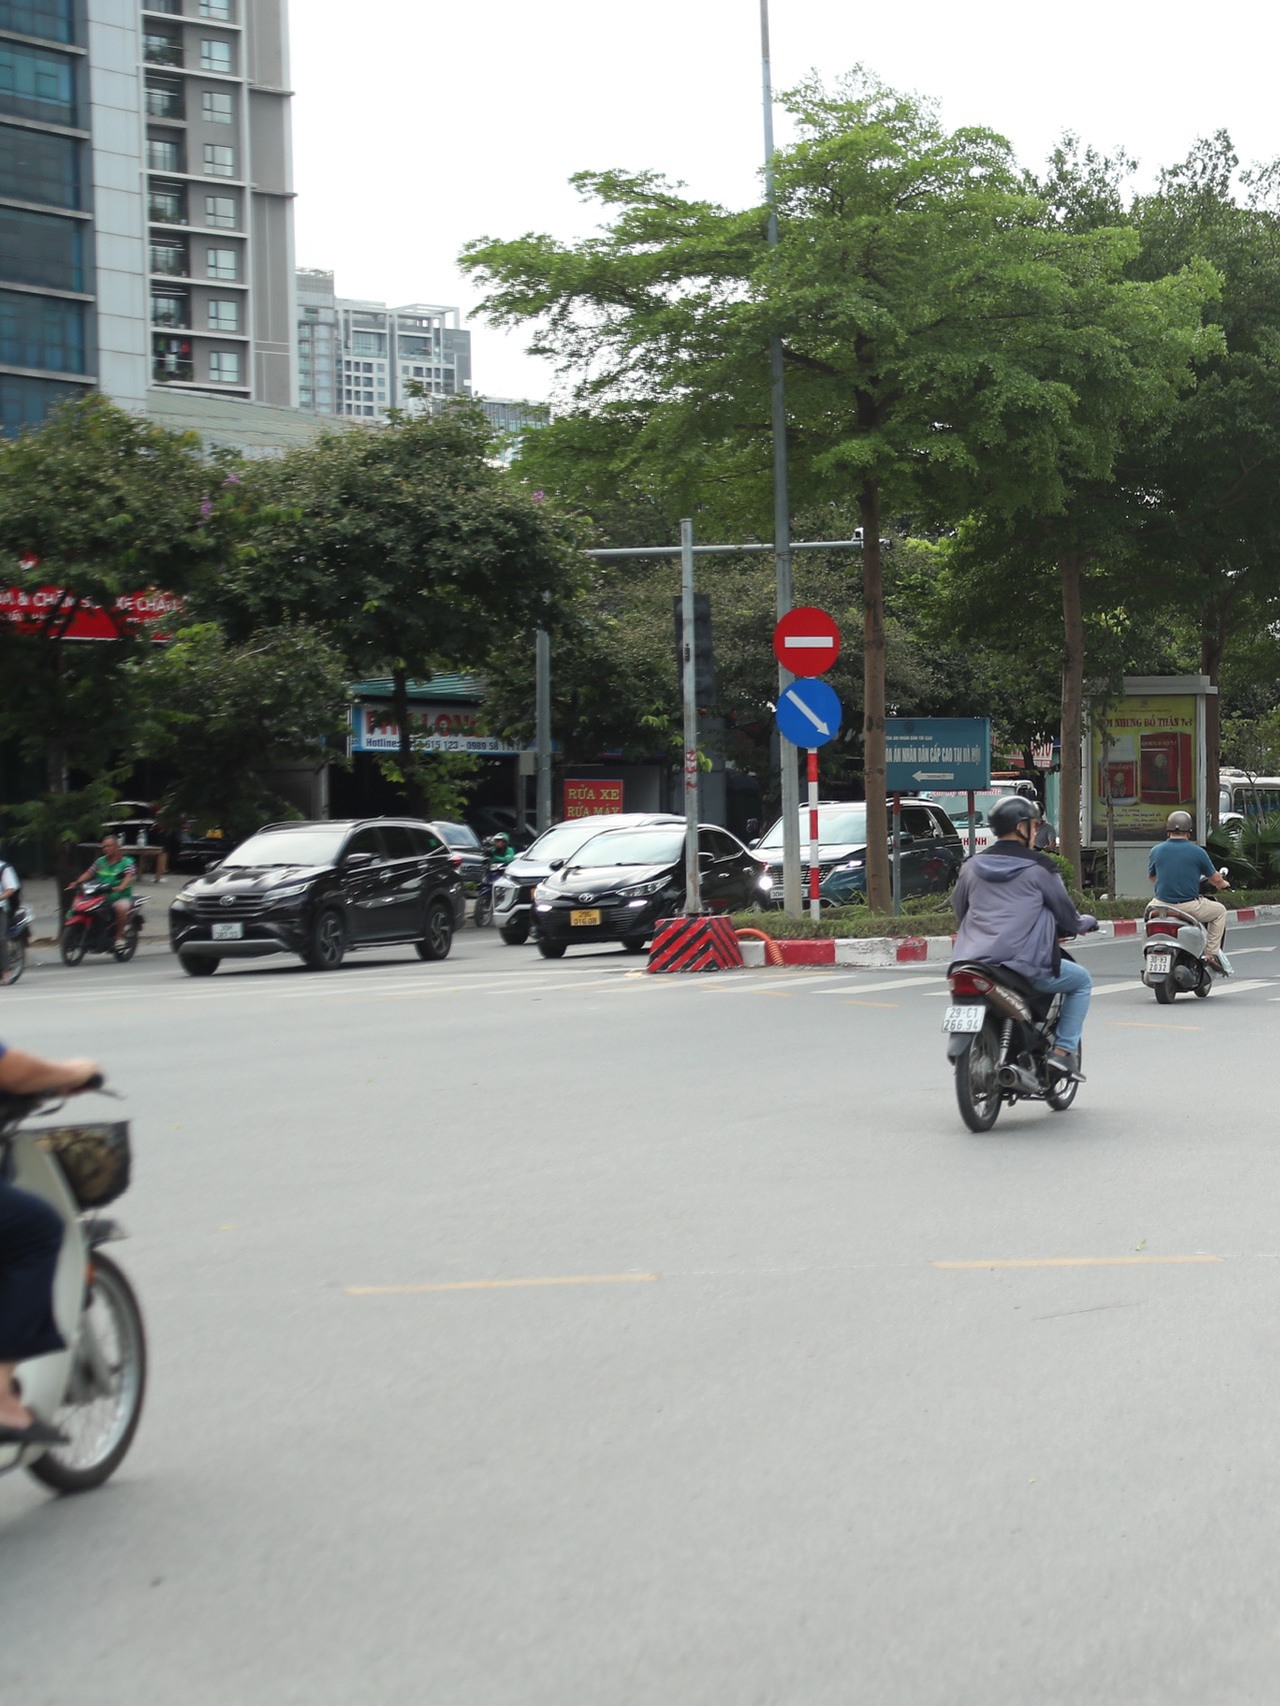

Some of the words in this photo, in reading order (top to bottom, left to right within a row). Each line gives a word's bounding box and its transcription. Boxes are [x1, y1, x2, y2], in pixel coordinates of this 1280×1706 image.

[942, 746, 953, 763] CAO
[567, 784, 596, 800] RỬA
[599, 788, 620, 800] XE
[567, 801, 590, 818] RỬA
[960, 837, 987, 846] HNH
[943, 1019, 978, 1031] 266.94
